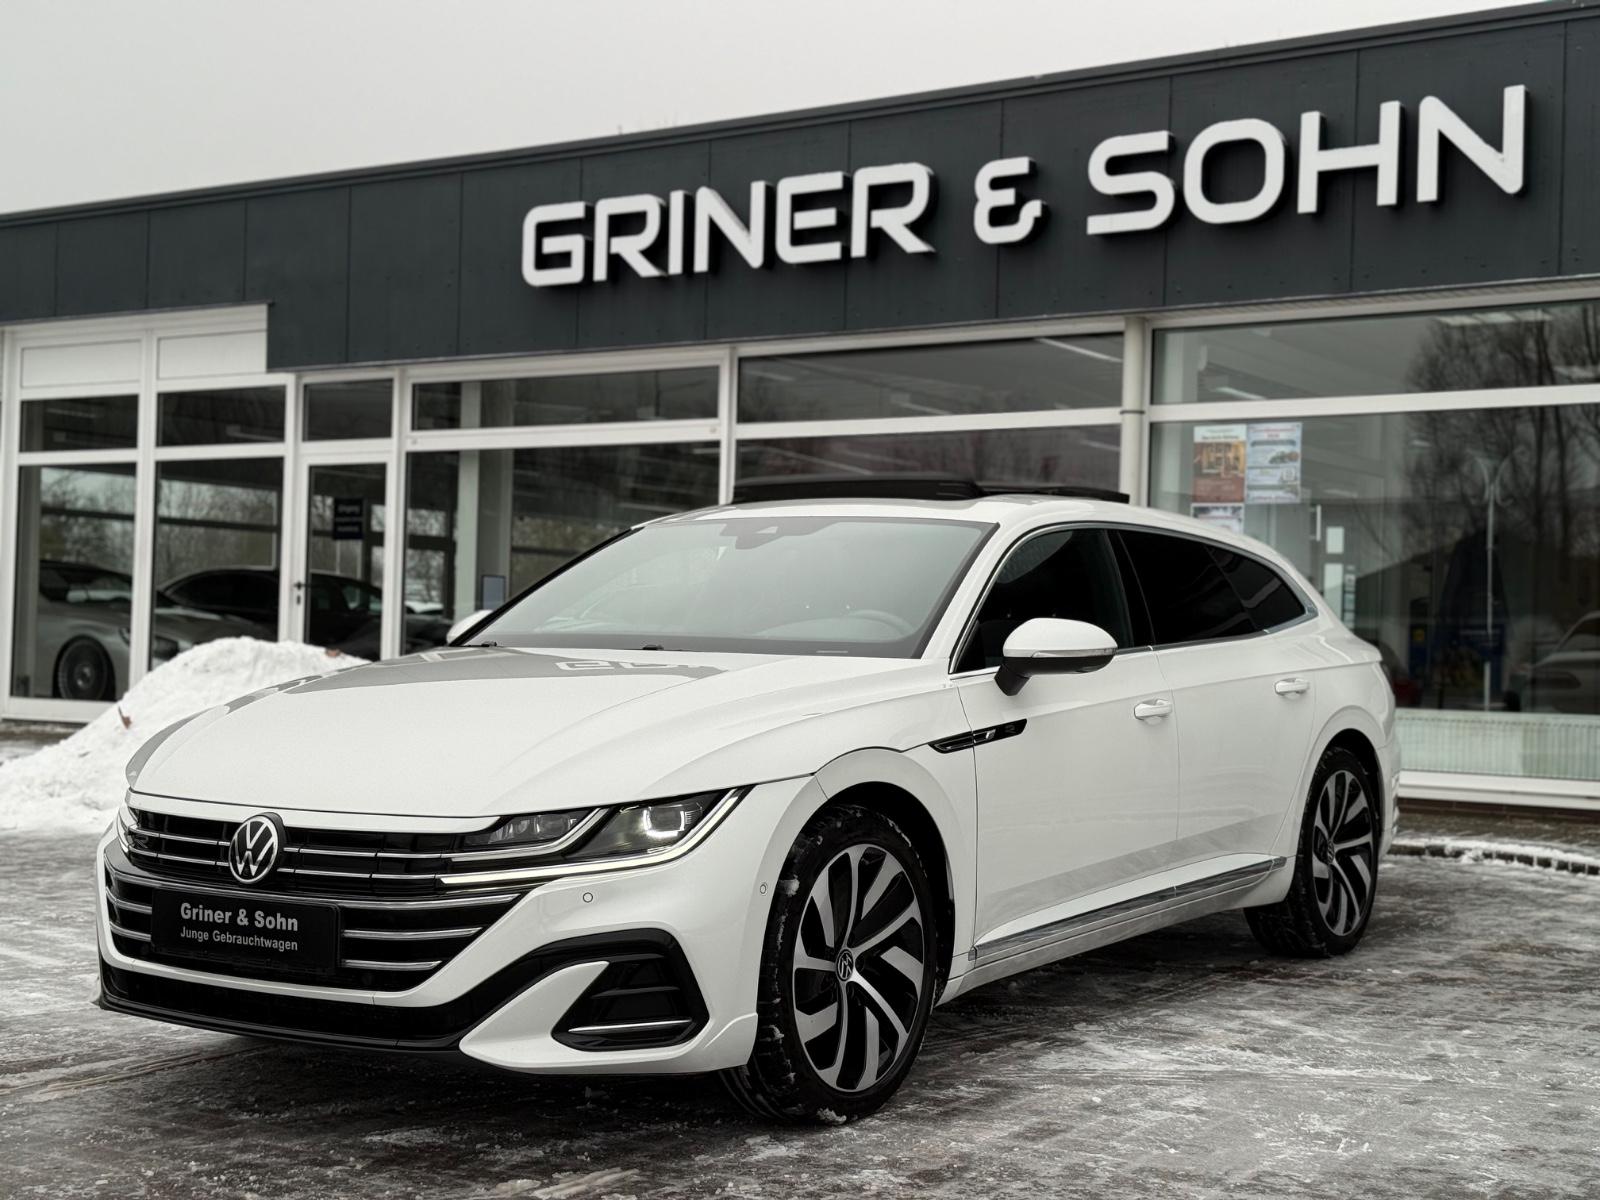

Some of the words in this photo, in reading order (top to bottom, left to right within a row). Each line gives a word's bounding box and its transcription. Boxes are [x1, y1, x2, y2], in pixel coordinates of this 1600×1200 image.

[522, 162, 936, 287] GRINER
[974, 156, 1042, 244] &
[1087, 84, 1526, 235] SOHN
[180, 902, 232, 924] Griner
[236, 908, 249, 926] &
[254, 911, 298, 931] Sohn
[180, 926, 209, 942] Junge
[212, 930, 298, 952] Gebrauchtwagen
